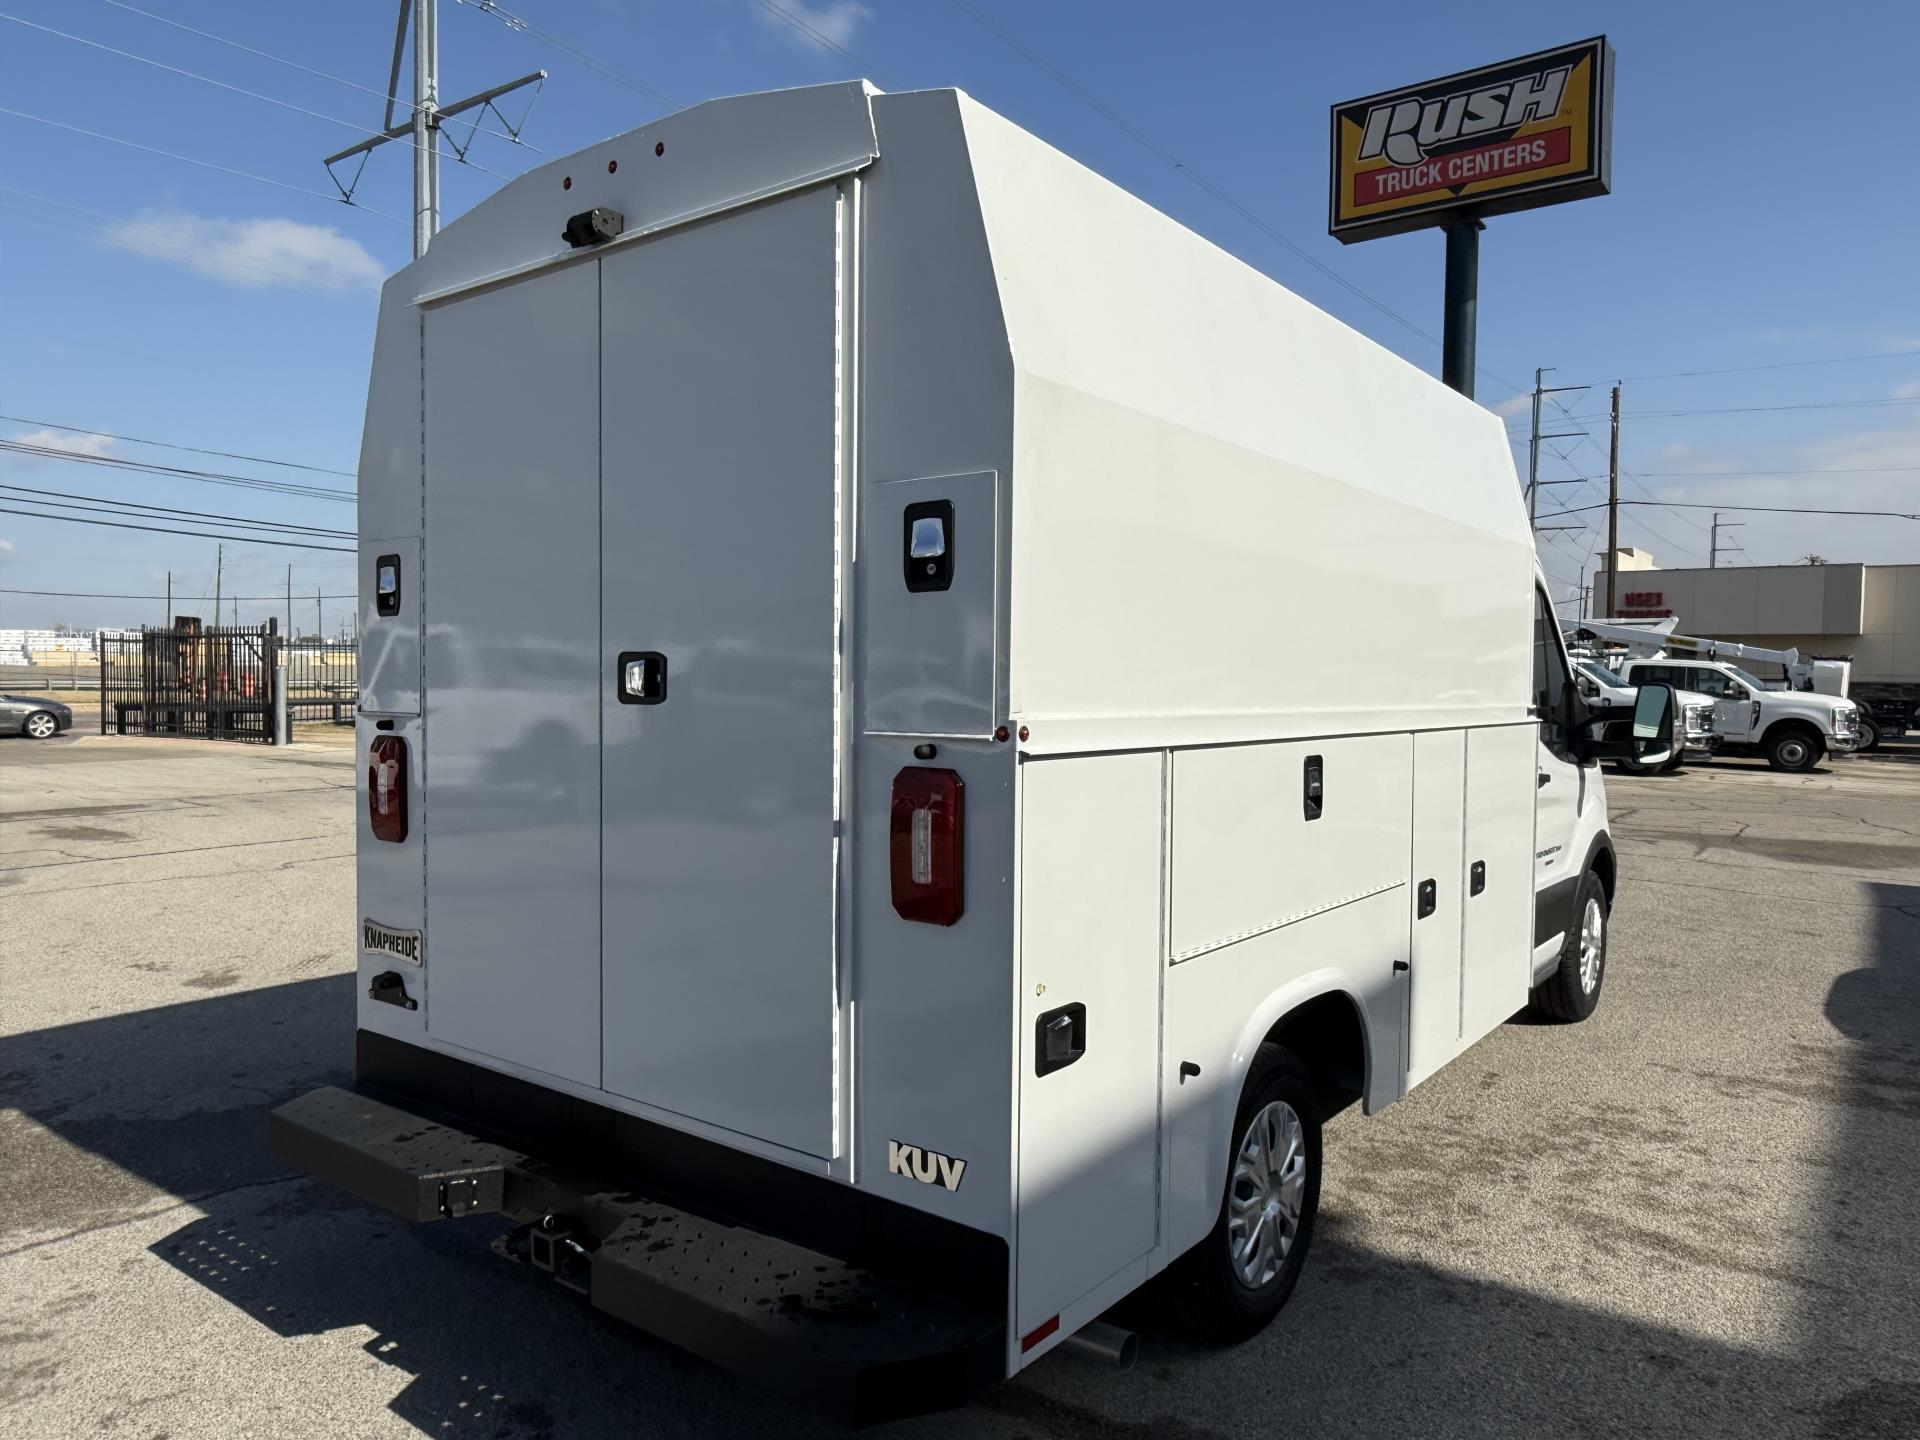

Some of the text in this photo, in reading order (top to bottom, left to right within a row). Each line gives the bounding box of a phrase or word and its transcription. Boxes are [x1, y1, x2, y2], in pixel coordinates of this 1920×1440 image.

[1356, 64, 1573, 167] RUSH
[1375, 139, 1546, 196] TRUCK CENTERS
[364, 924, 419, 962] KNAPHEIDE
[888, 1139, 968, 1192] KUV
